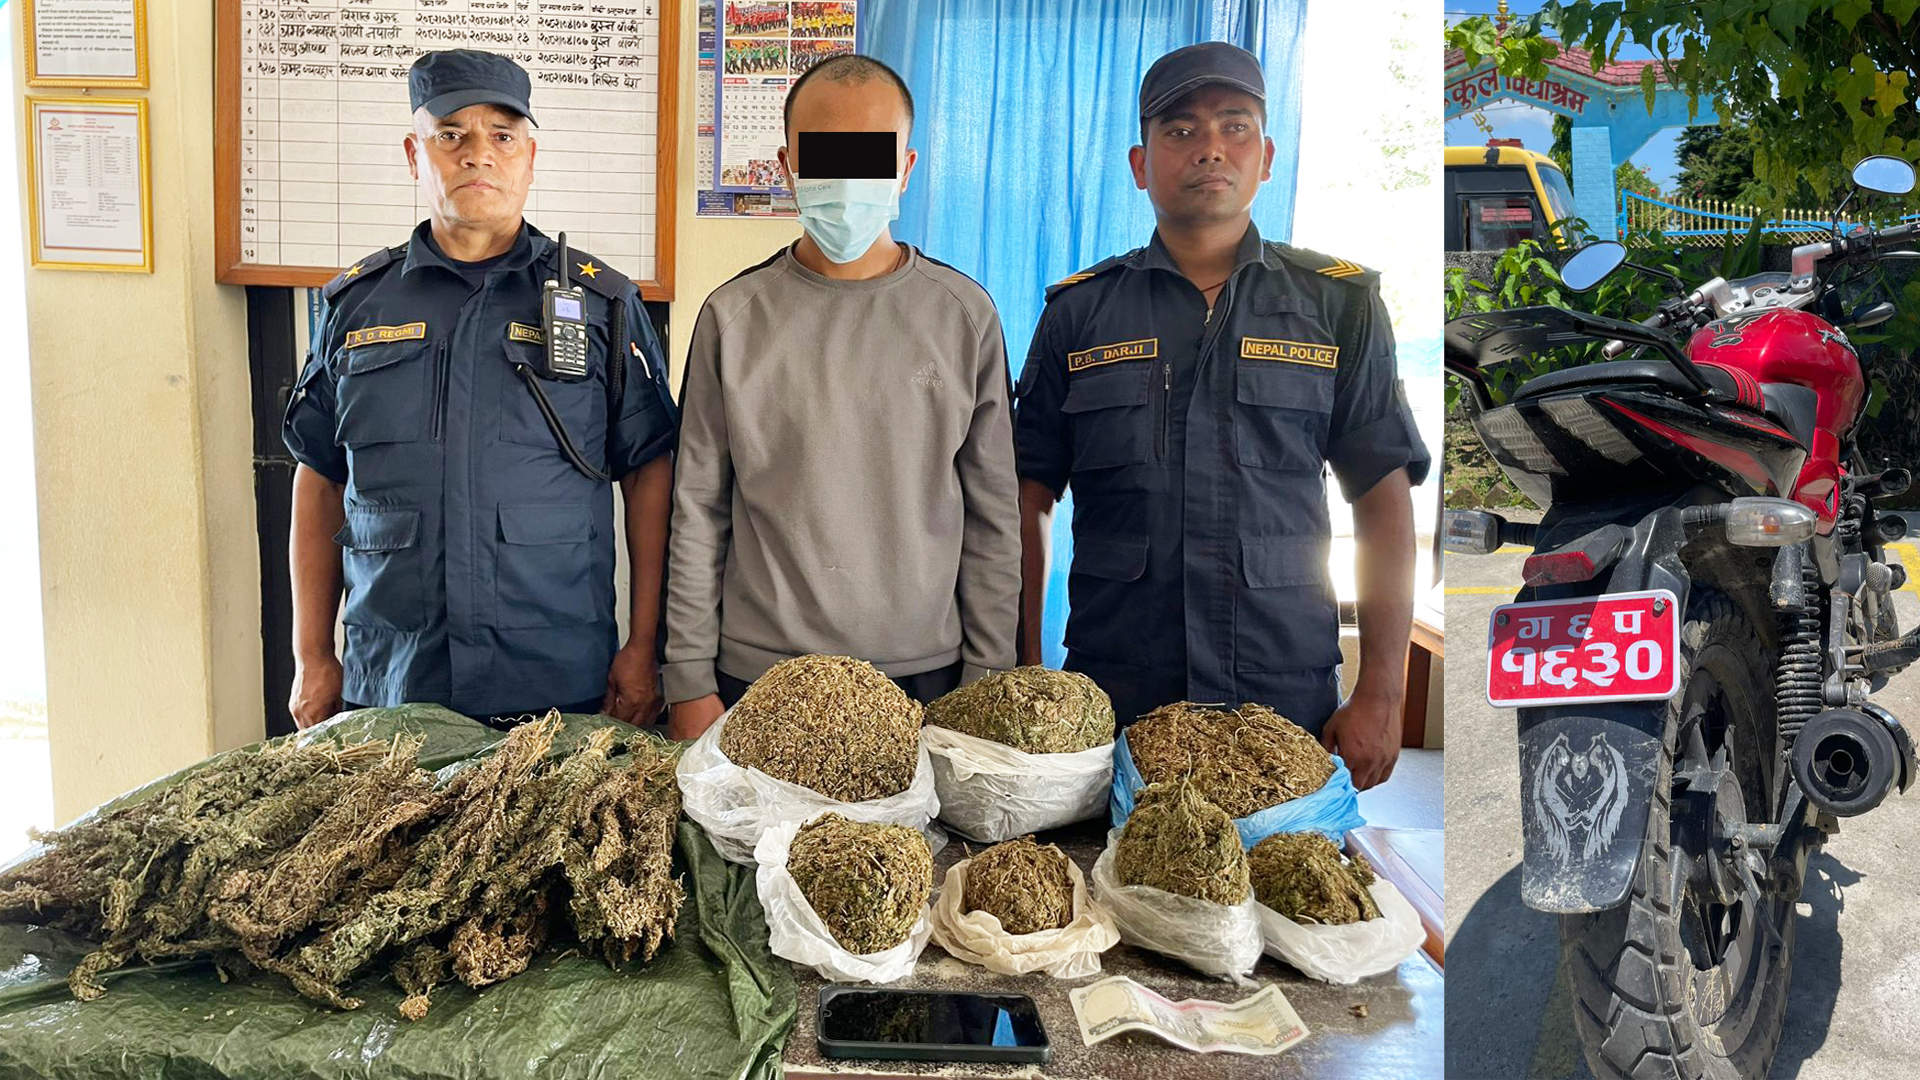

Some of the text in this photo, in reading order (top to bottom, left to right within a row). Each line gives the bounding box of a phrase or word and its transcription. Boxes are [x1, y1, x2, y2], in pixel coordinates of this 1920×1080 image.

[1444, 66, 1500, 110] कुल
[379, 327, 415, 339] REGMI
[514, 327, 543, 342] NEPA
[1103, 345, 1144, 360] DARJI
[1245, 342, 1333, 363] NEPAL POLICE
[1518, 615, 1554, 640] ग
[1612, 610, 1645, 634] प
[1501, 639, 1663, 690] १६३०
